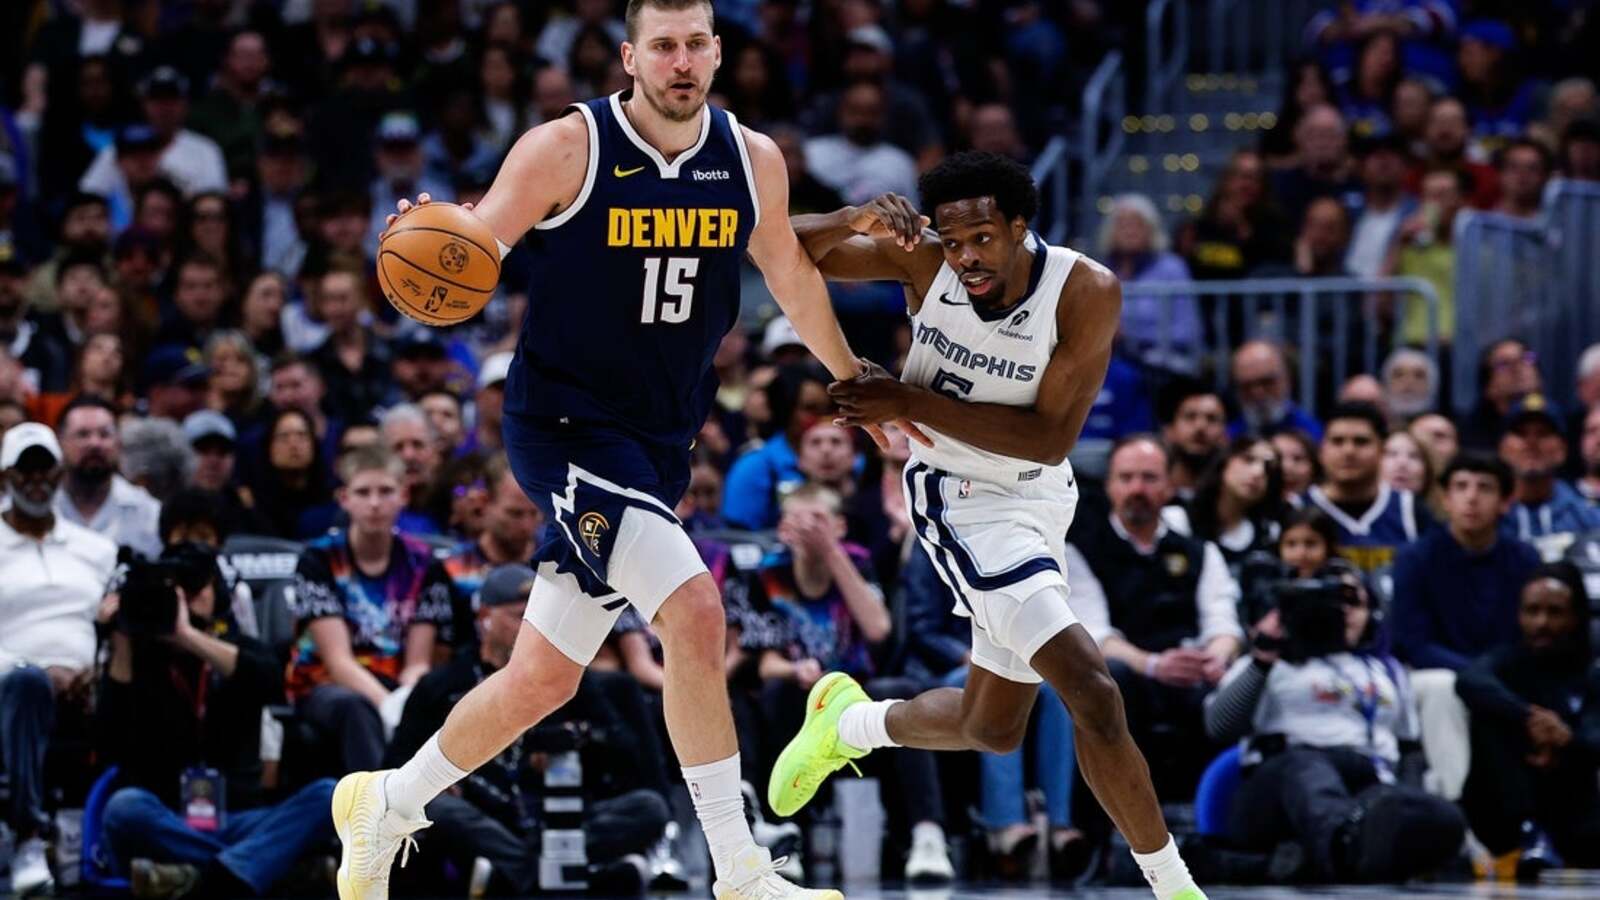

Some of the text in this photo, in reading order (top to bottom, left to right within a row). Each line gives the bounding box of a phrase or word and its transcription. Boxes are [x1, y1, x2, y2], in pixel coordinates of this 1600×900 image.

[692, 169, 730, 181] ibotta
[607, 207, 739, 248] DENVER
[640, 257, 700, 324] 15
[916, 322, 1037, 382] MEMPHIS
[997, 327, 1033, 342] Robinhood
